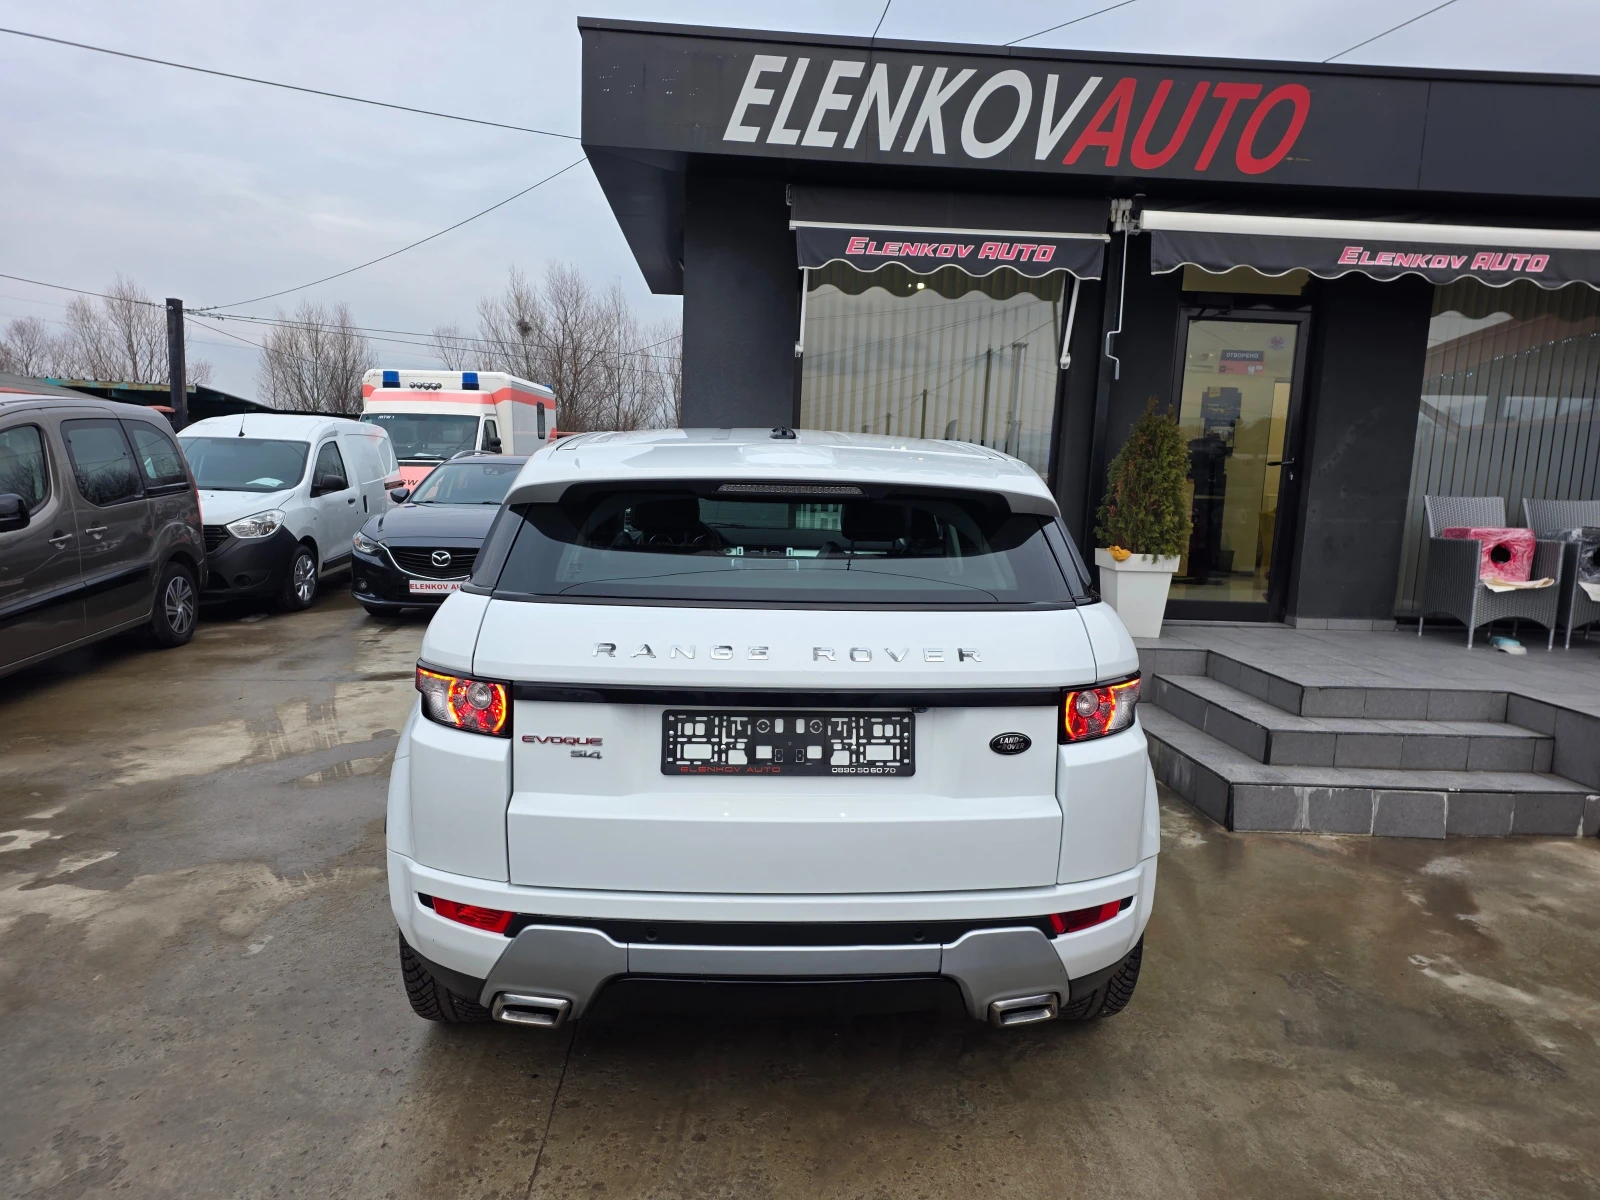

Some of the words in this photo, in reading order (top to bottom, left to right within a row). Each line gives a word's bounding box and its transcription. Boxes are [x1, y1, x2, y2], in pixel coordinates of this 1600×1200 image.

[845, 236, 975, 258] ELENKOV
[977, 241, 1057, 262] AUTO
[1337, 246, 1468, 269] ELENKOV
[1470, 252, 1550, 273] AUTO
[592, 642, 769, 660] RANGE
[812, 646, 982, 662] ROVER
[521, 735, 603, 747] EVOQUE
